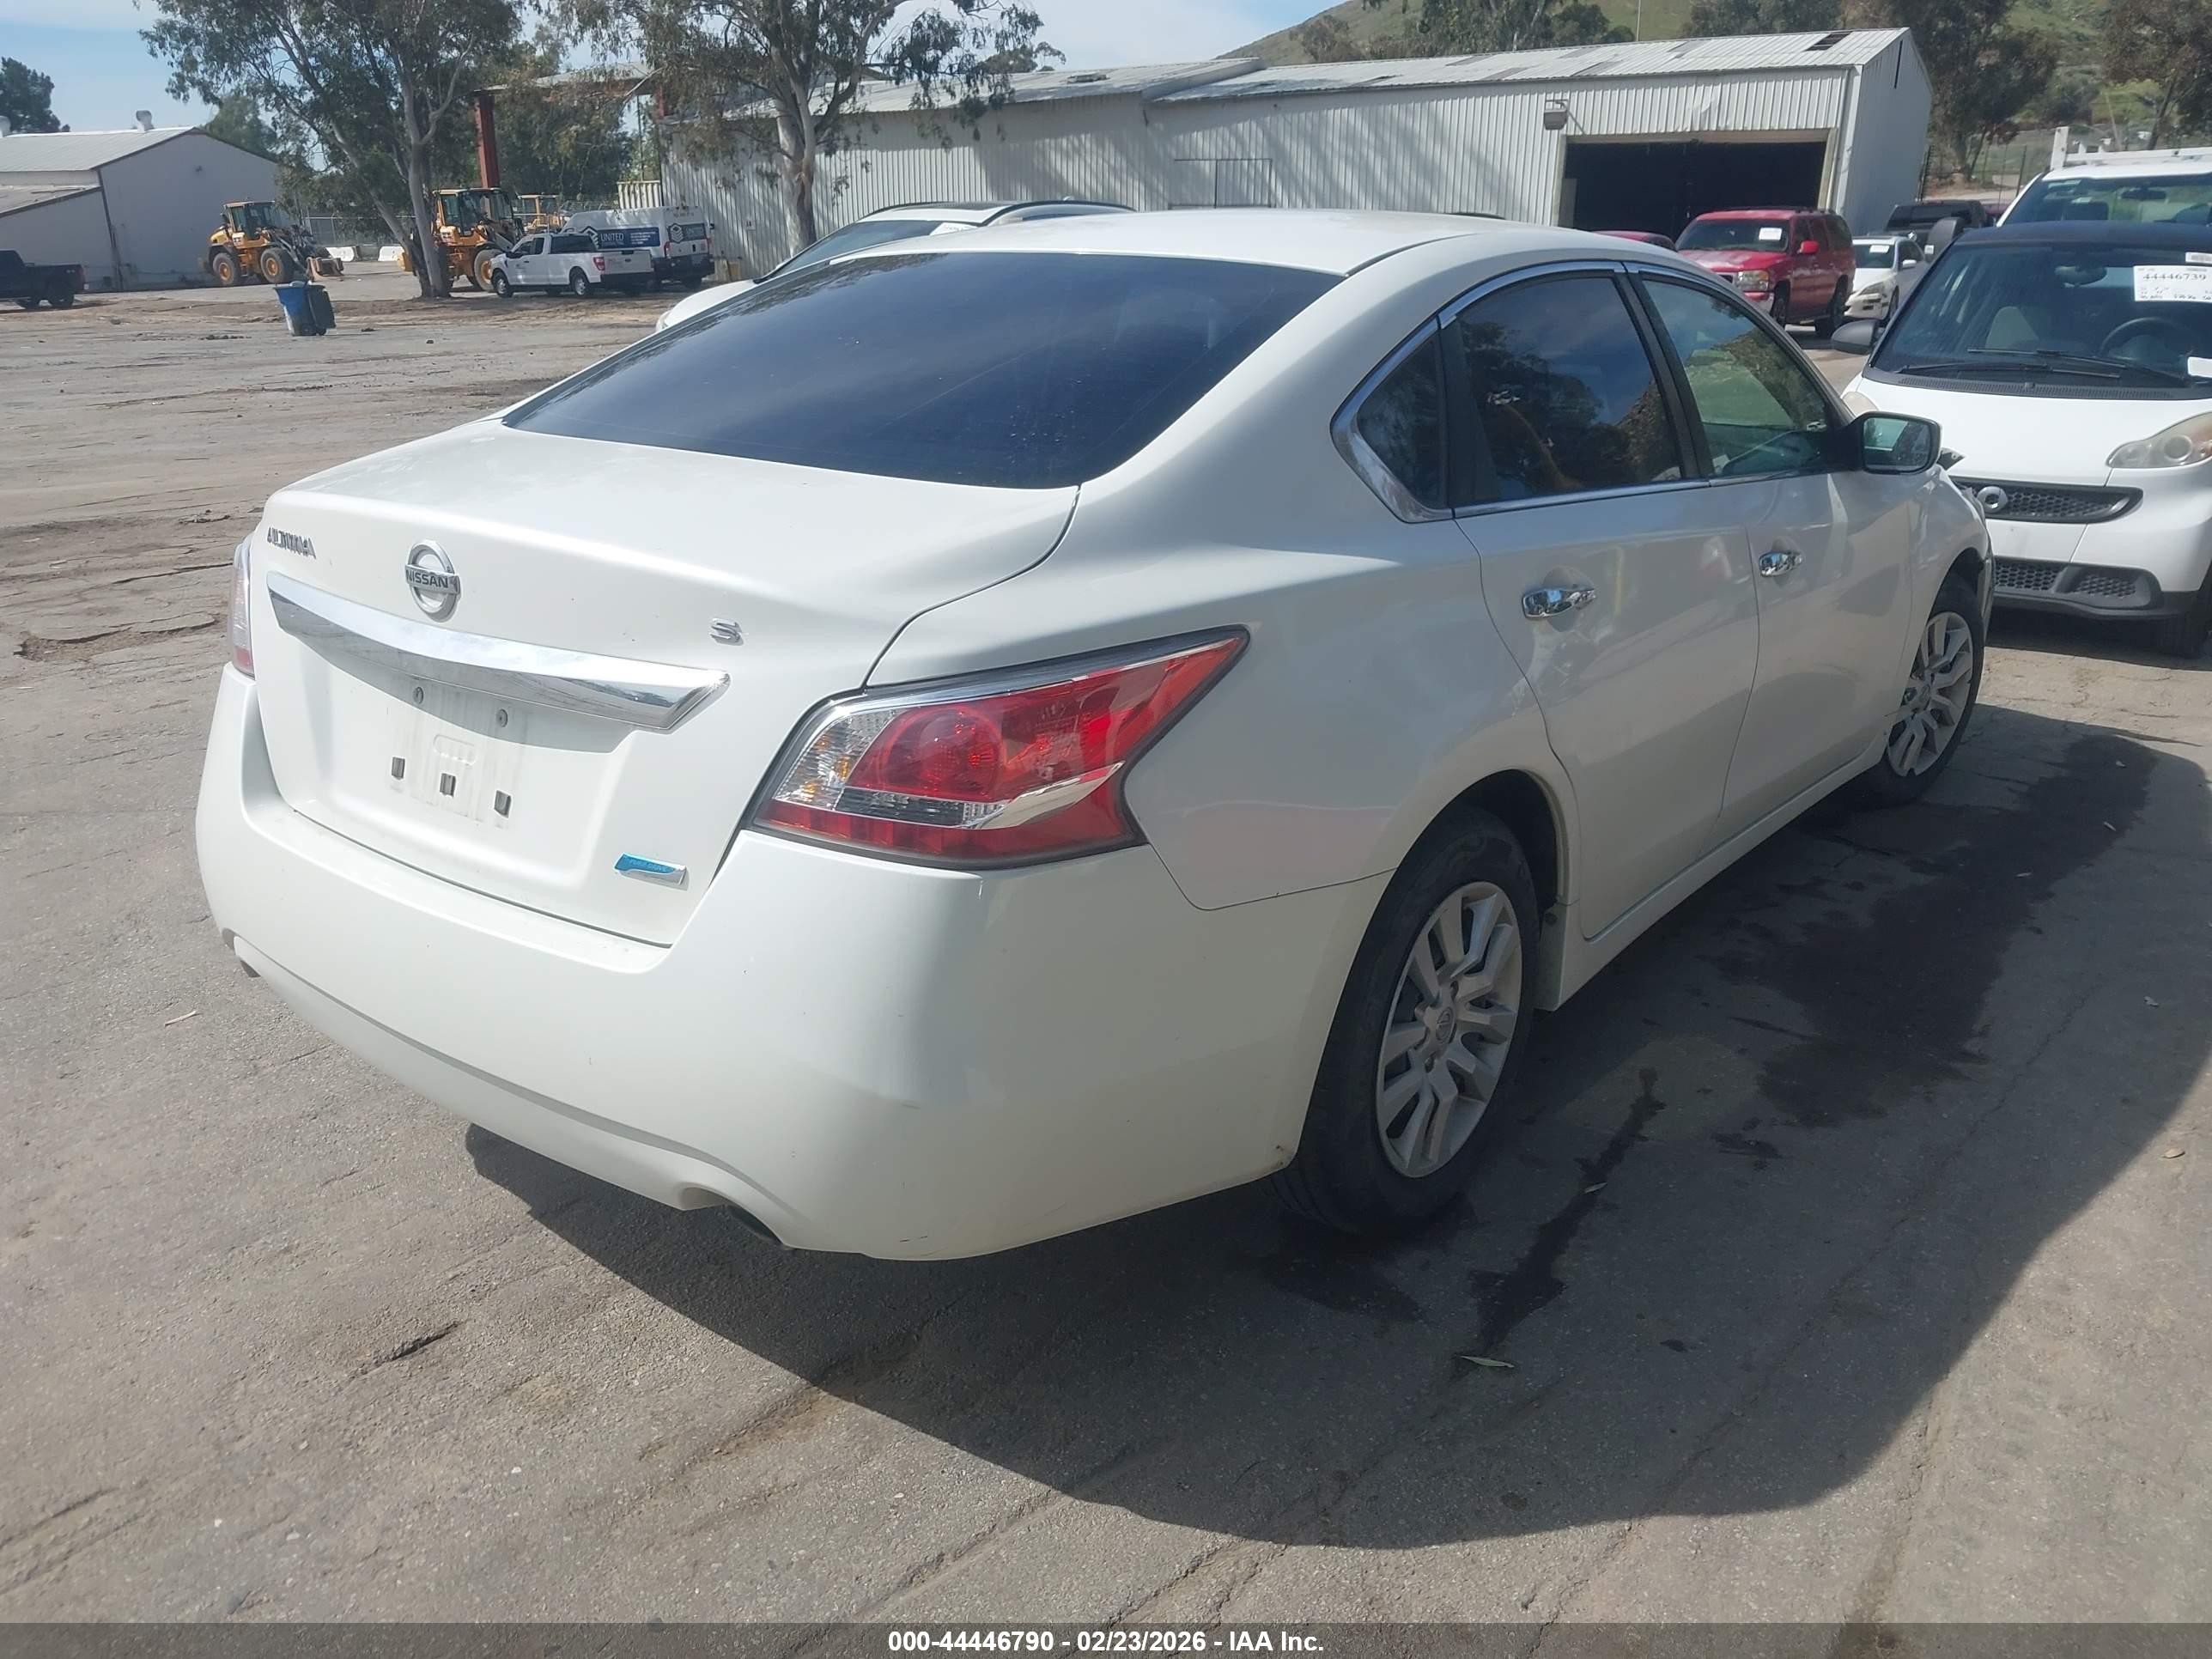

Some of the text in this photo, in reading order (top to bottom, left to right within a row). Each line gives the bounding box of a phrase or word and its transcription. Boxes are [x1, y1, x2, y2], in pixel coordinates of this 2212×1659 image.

[600, 233, 624, 241] UNITED
[406, 569, 449, 588] NISSAN
[710, 619, 742, 643] S
